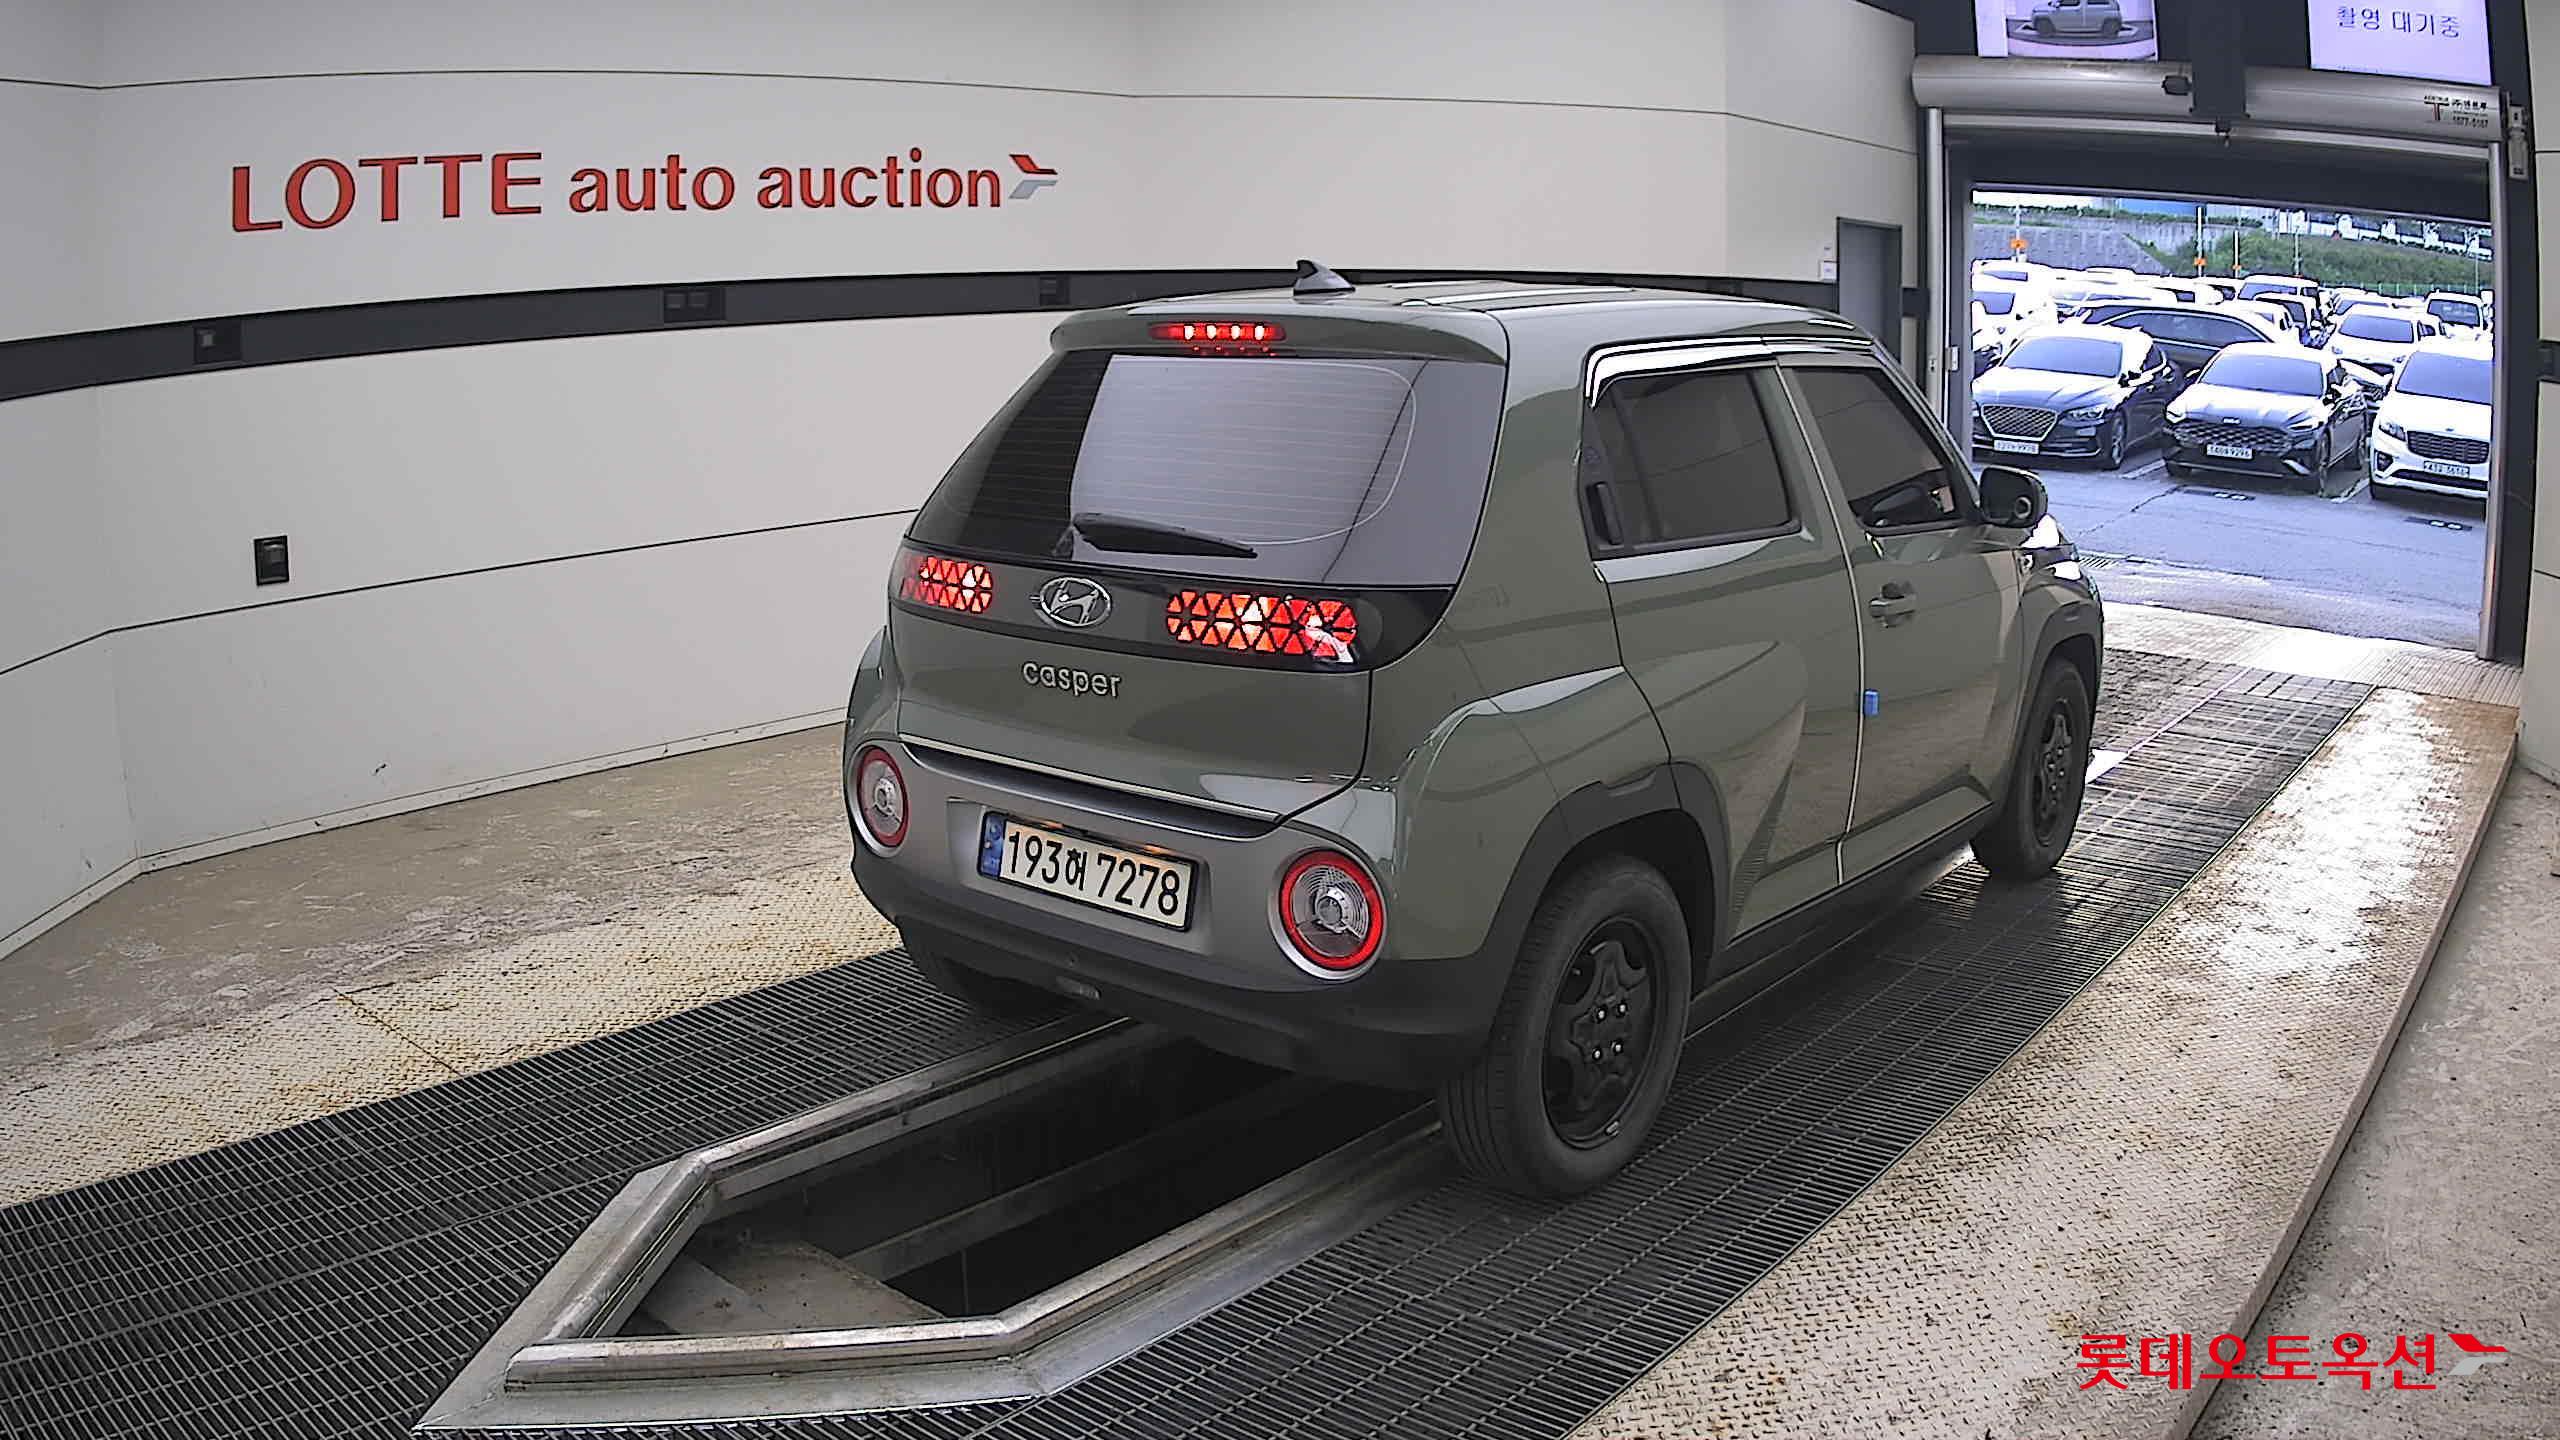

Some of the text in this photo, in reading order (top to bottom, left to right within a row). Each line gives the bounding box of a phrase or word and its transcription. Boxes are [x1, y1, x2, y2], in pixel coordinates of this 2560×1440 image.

[2338, 6, 2460, 39] 촬영 대기중
[232, 147, 1001, 232] LOTTE auto auction
[1022, 661, 1121, 698] casper
[1008, 831, 1180, 916] 193허 7278
